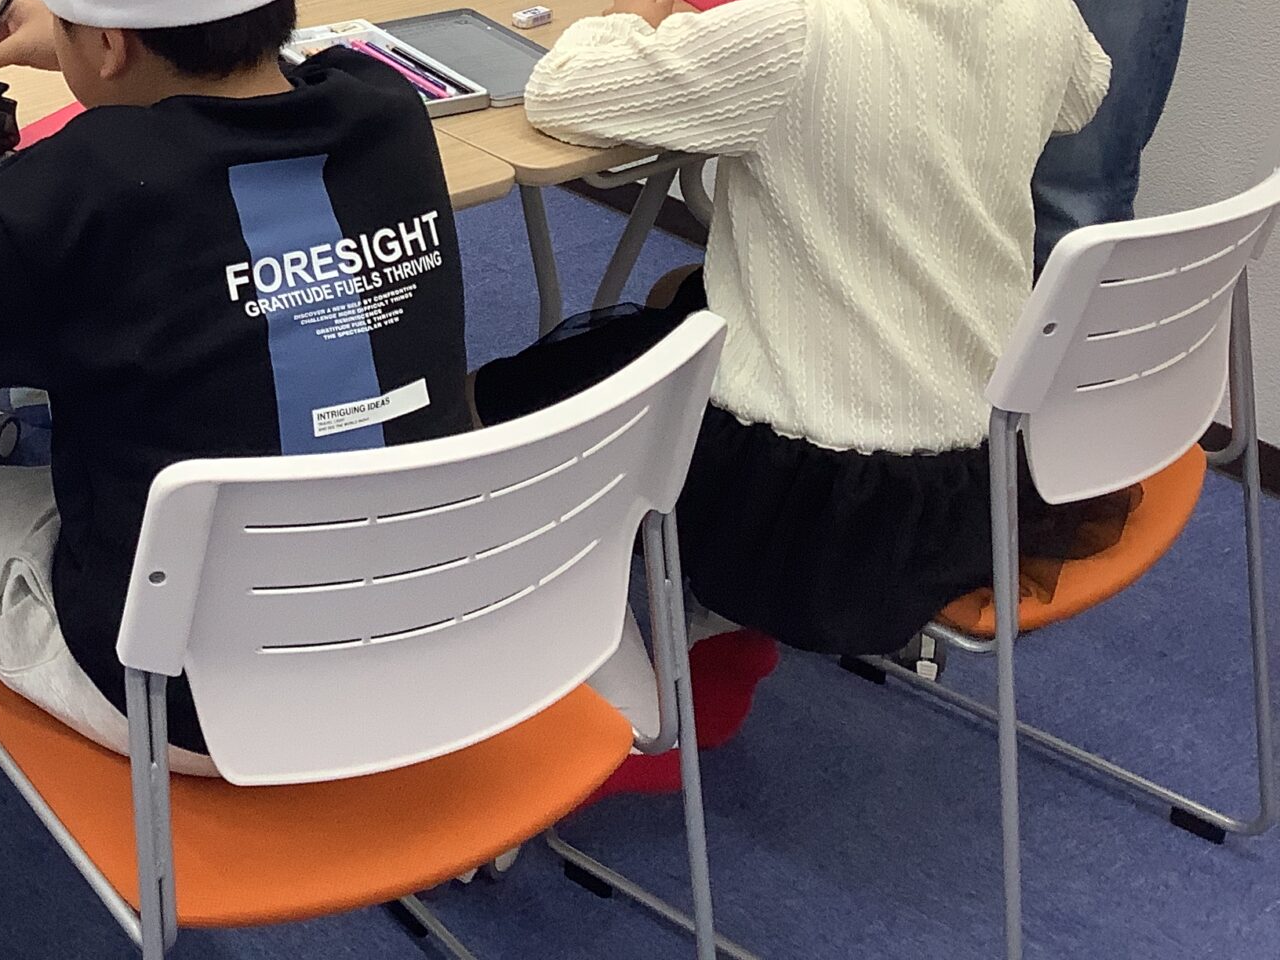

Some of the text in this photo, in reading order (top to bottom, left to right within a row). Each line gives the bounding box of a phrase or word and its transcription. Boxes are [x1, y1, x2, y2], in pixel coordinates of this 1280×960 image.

[225, 210, 440, 301] FORESIGHT
[244, 250, 442, 318] GRATITUDE FUELS THRIVING
[293, 308, 326, 321] DISCOVER
[332, 304, 346, 312] NEW
[347, 301, 362, 309] SELF
[373, 284, 418, 302] CONFRONTING
[300, 292, 413, 326] CHALLENGE MORE DIFFICULT THINGS
[334, 309, 382, 325] REMINISCENCE
[315, 308, 404, 335] GRATITUDE FUELS THRIVING
[323, 316, 400, 340] THE SPECTACULAR VIEW
[317, 404, 366, 421] INTRIGUING
[367, 396, 391, 411] IDEAS
